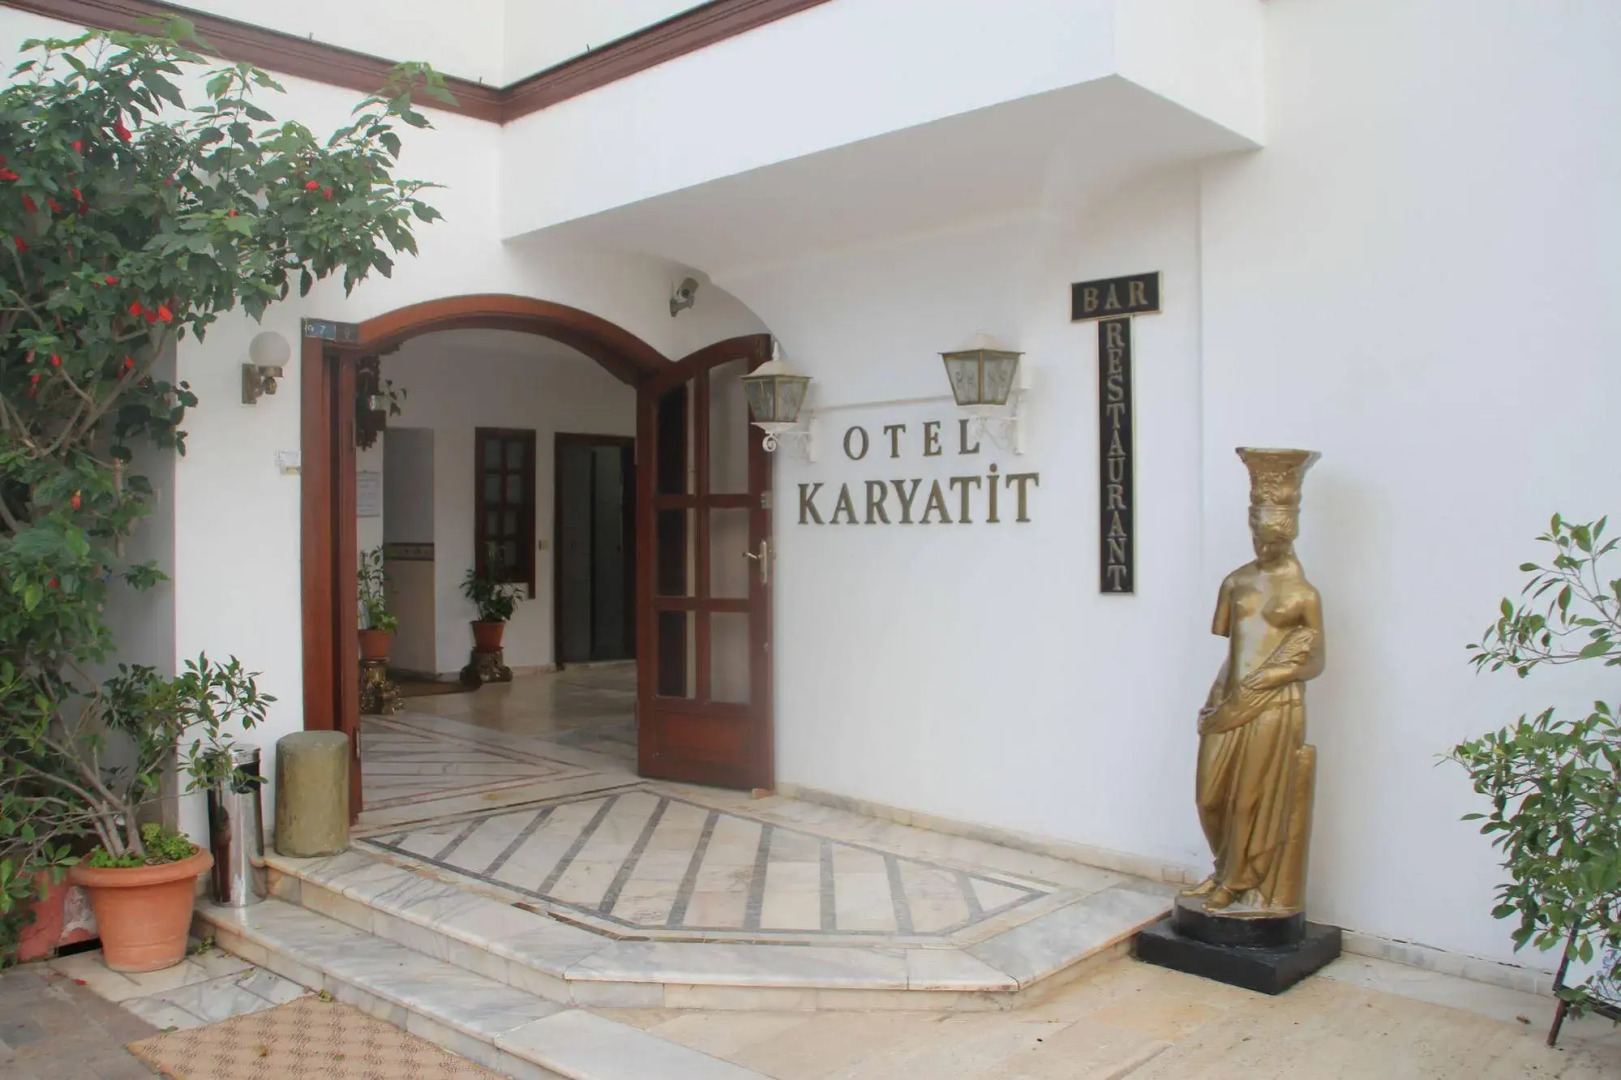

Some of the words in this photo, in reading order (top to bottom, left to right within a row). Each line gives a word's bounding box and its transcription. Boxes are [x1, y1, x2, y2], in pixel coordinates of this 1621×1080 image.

[1083, 281, 1149, 313] BAR
[843, 418, 980, 460] OTEL
[1106, 322, 1127, 591] RESTAURANT
[797, 462, 1040, 525] KARYATİT
